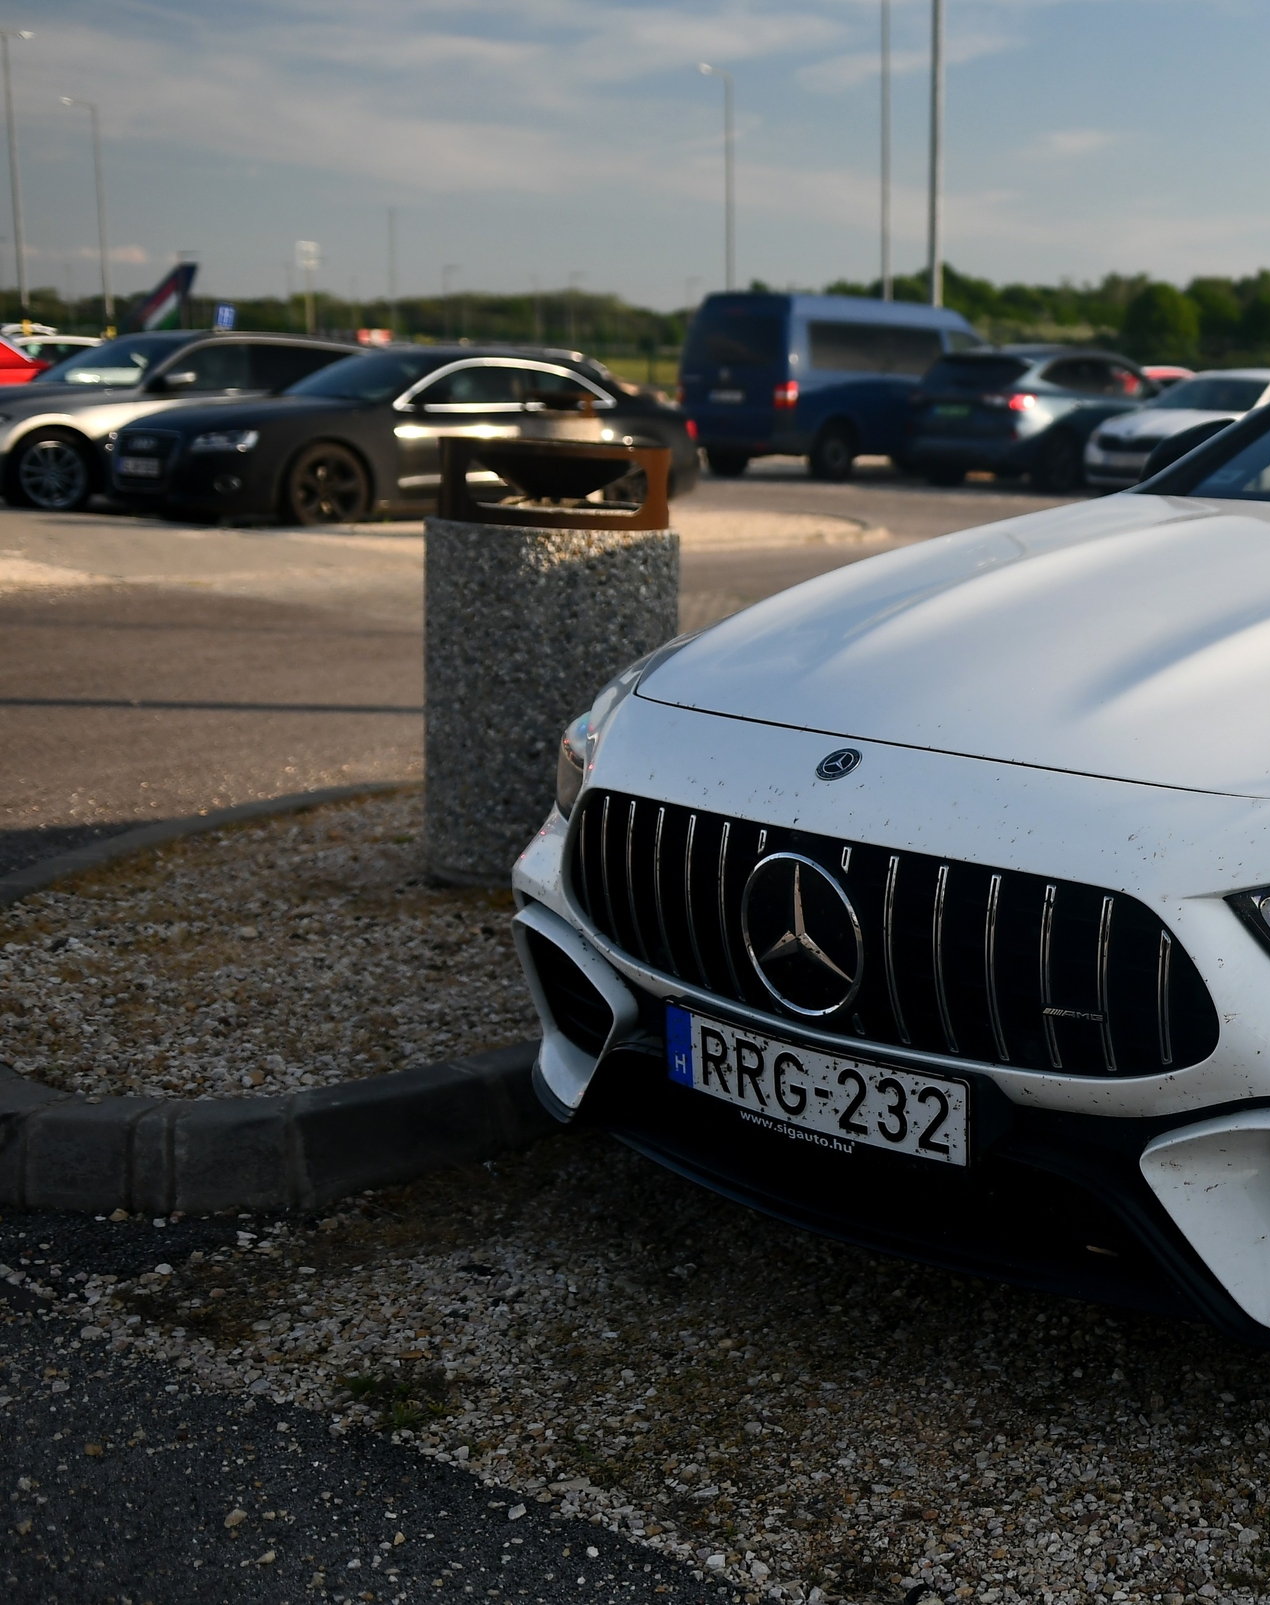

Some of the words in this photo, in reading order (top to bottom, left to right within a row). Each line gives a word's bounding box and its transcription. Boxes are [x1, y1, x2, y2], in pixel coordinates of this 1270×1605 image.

[1061, 1010, 1104, 1022] AMG
[674, 1051, 686, 1075] H
[700, 1025, 950, 1154] RRG-232
[740, 1110, 853, 1154] www.sigauto.hu
